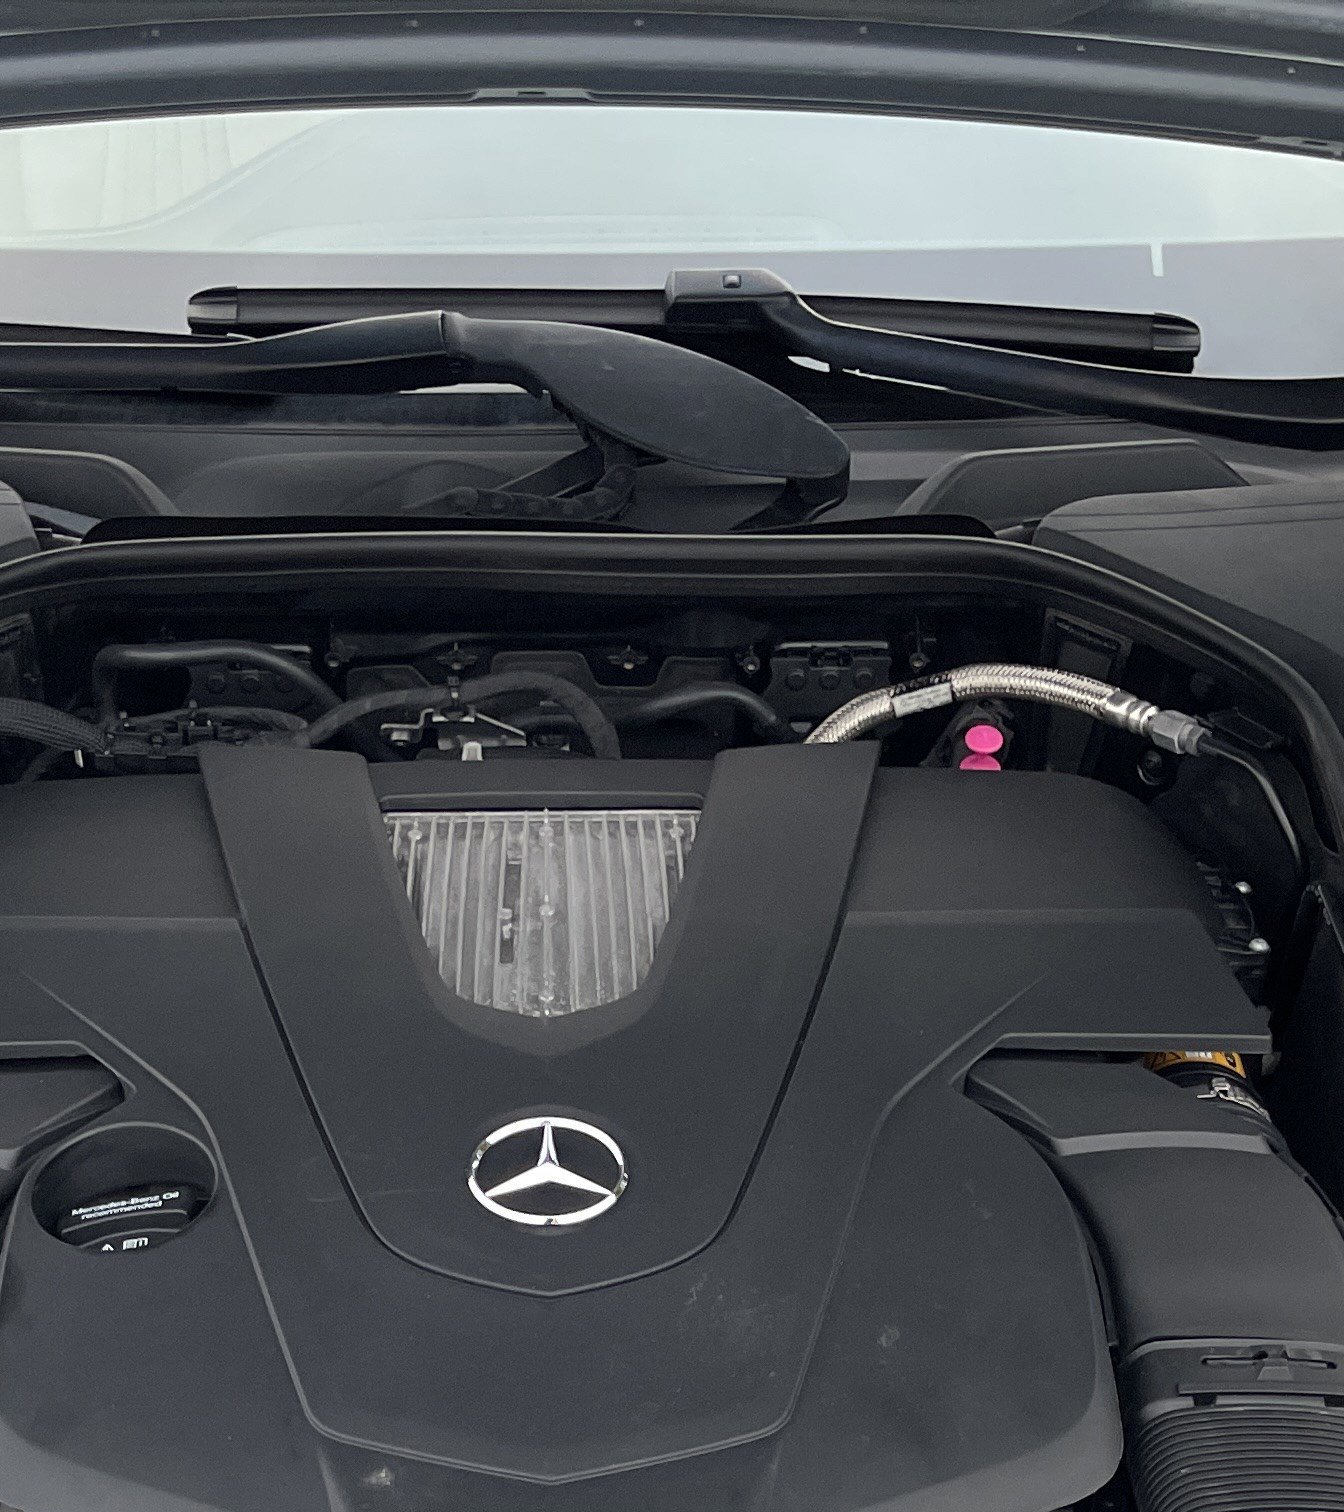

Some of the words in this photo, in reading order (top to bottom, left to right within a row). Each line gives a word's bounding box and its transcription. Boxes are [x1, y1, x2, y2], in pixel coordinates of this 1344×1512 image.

[71, 1195, 160, 1216] Mercedes-Benz
[162, 1191, 180, 1200] Oil
[81, 1200, 163, 1220] recommended
